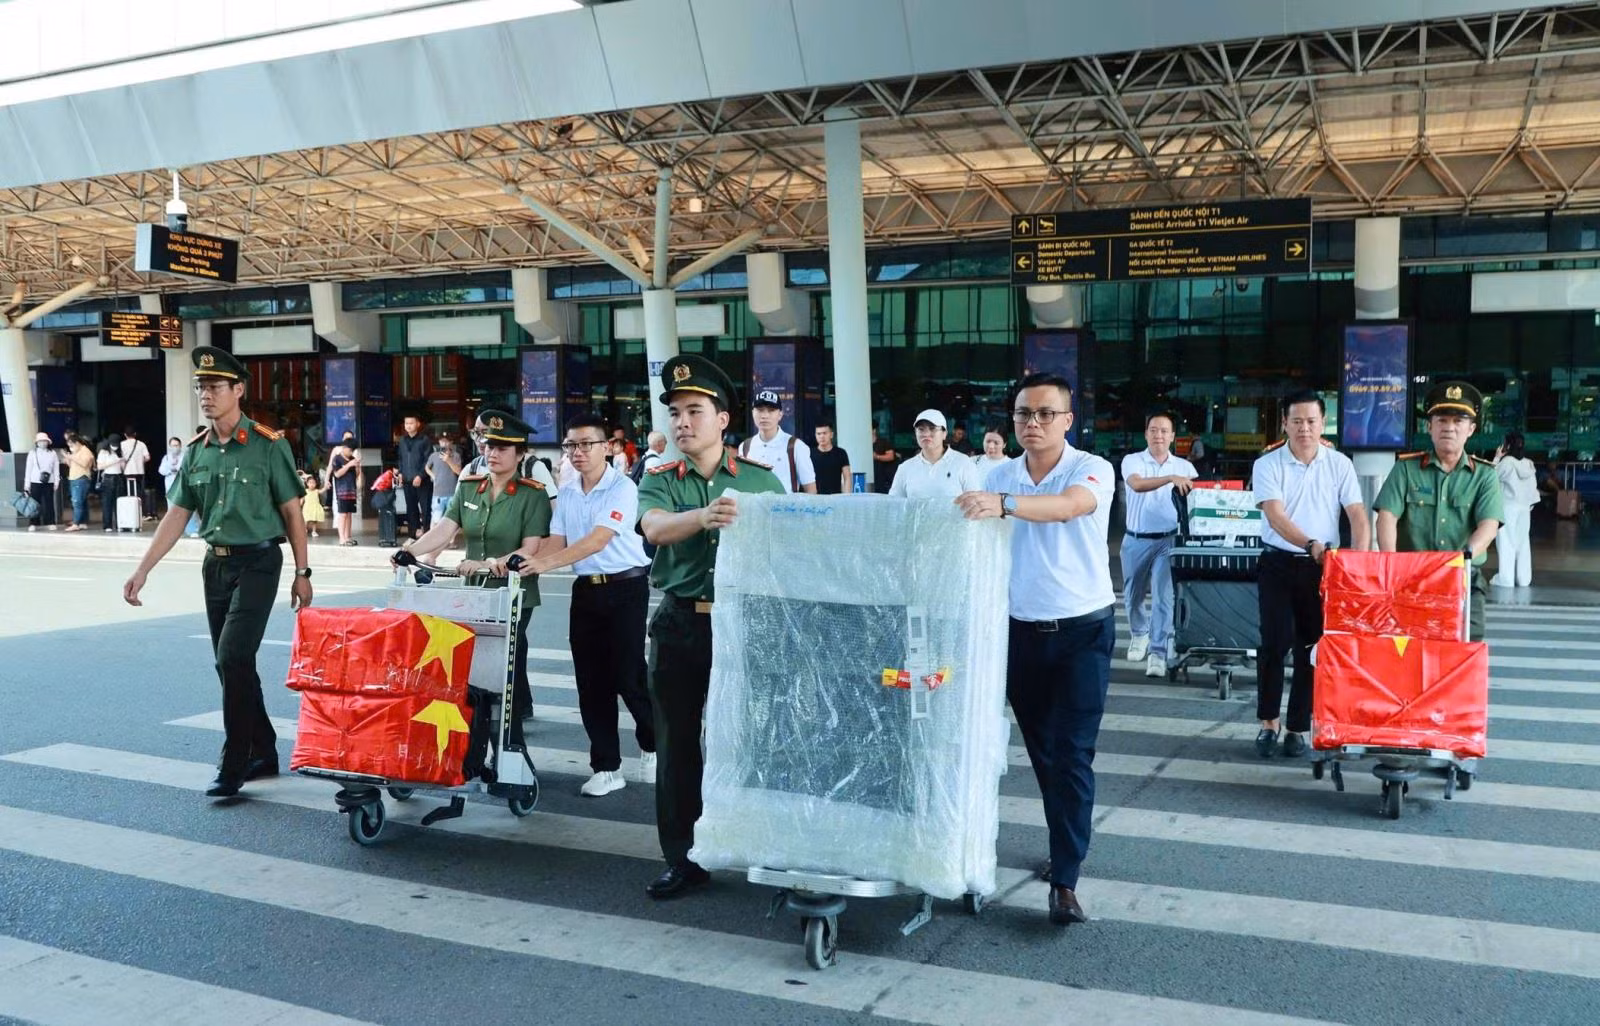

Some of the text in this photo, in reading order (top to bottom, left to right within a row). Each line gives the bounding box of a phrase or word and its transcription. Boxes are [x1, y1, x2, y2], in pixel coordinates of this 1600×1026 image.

[1172, 207, 1193, 219] QUỐC
[1195, 207, 1210, 218] NỘI
[1211, 207, 1221, 215] T1
[1130, 215, 1249, 230] Domestic Arrivals T1 Vietjet Air
[504, 606, 518, 730] GOLDSUN GROUP
